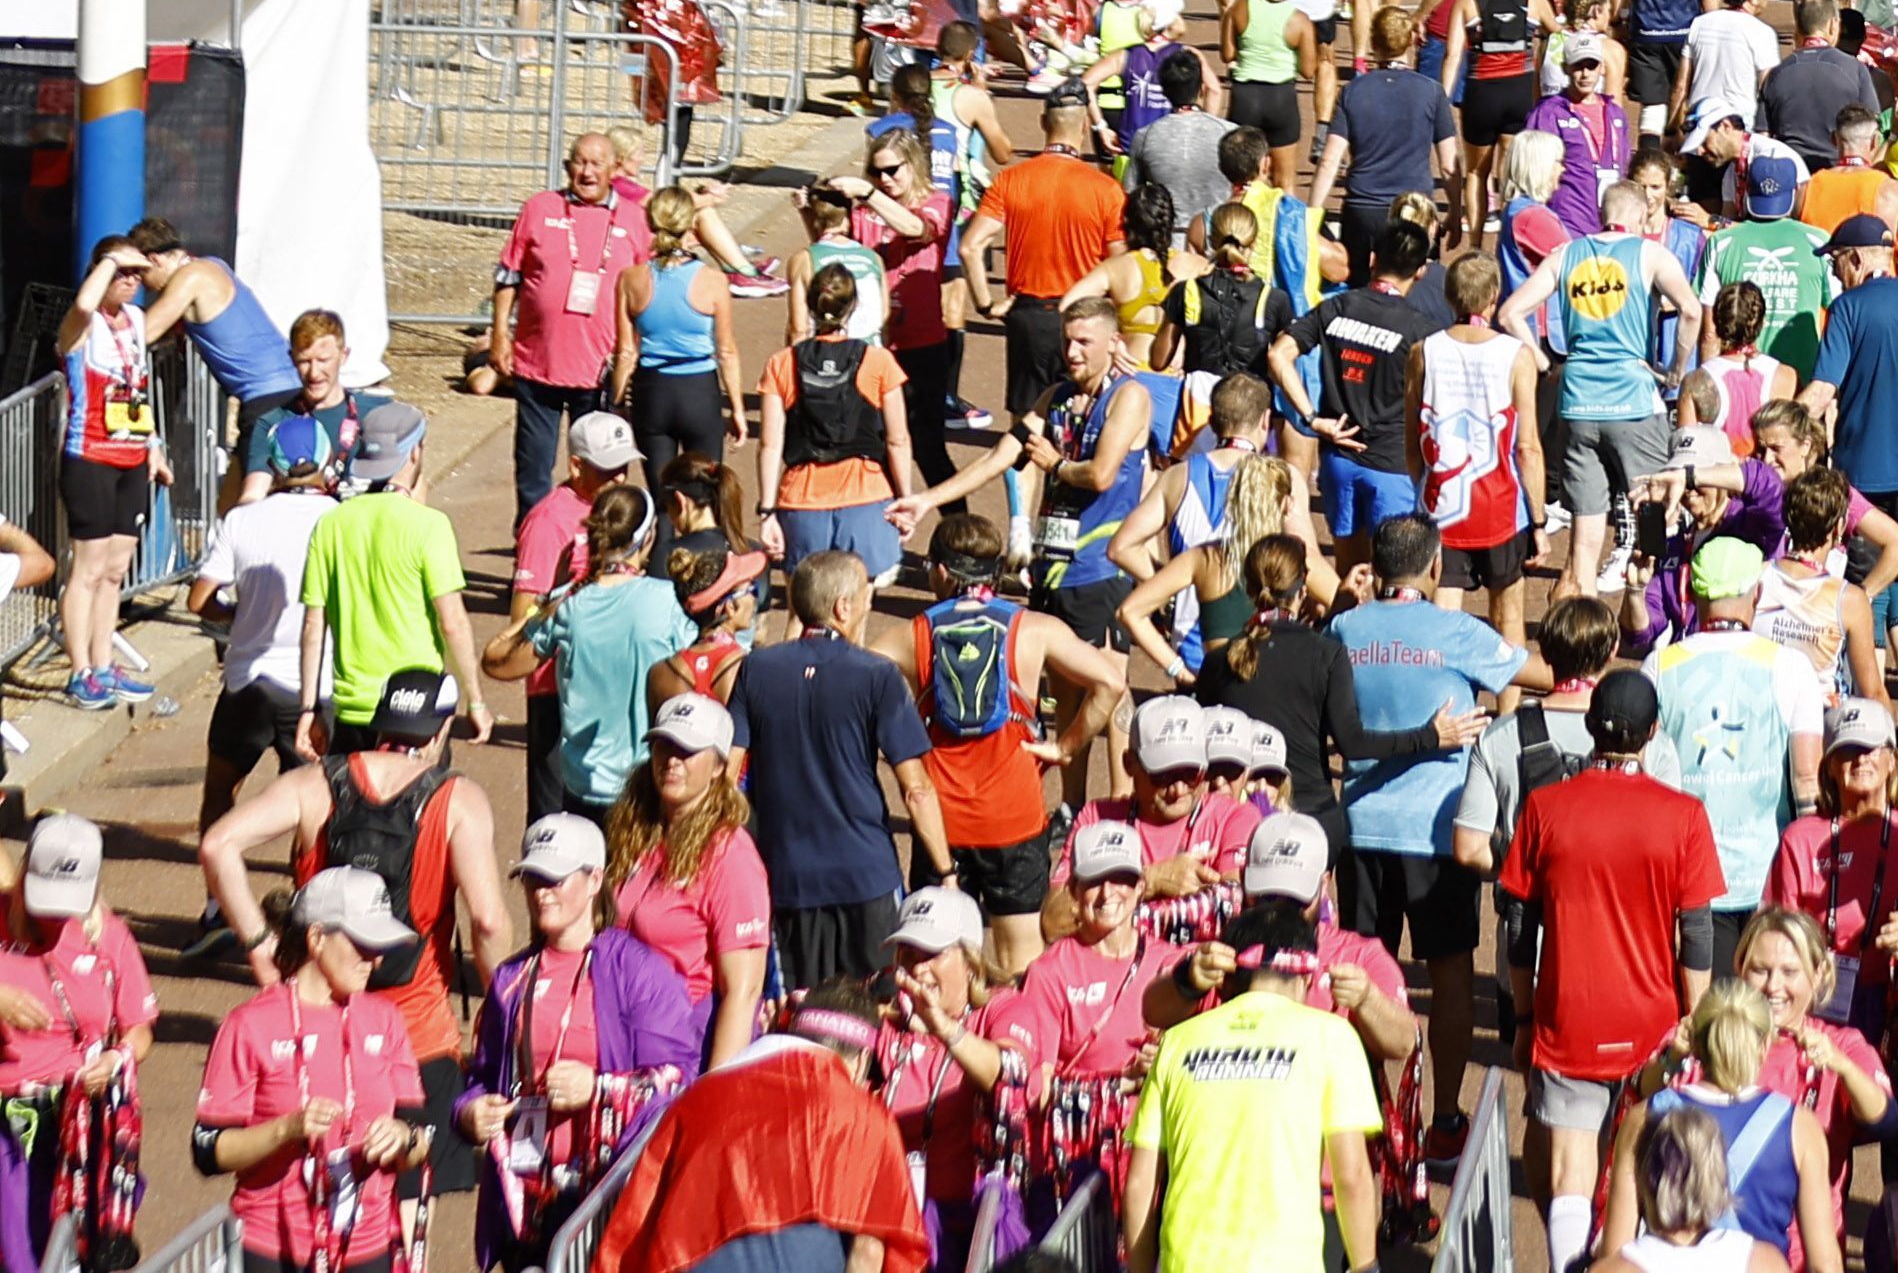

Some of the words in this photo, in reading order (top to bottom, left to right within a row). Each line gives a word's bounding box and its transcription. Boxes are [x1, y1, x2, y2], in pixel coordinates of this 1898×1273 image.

[1571, 278, 1625, 299] Kids
[1325, 316, 1404, 354] AWAKEN
[1772, 626, 1819, 645] Research
[1717, 769, 1759, 784] Cancer
[1194, 1063, 1293, 1081] RUNNER
